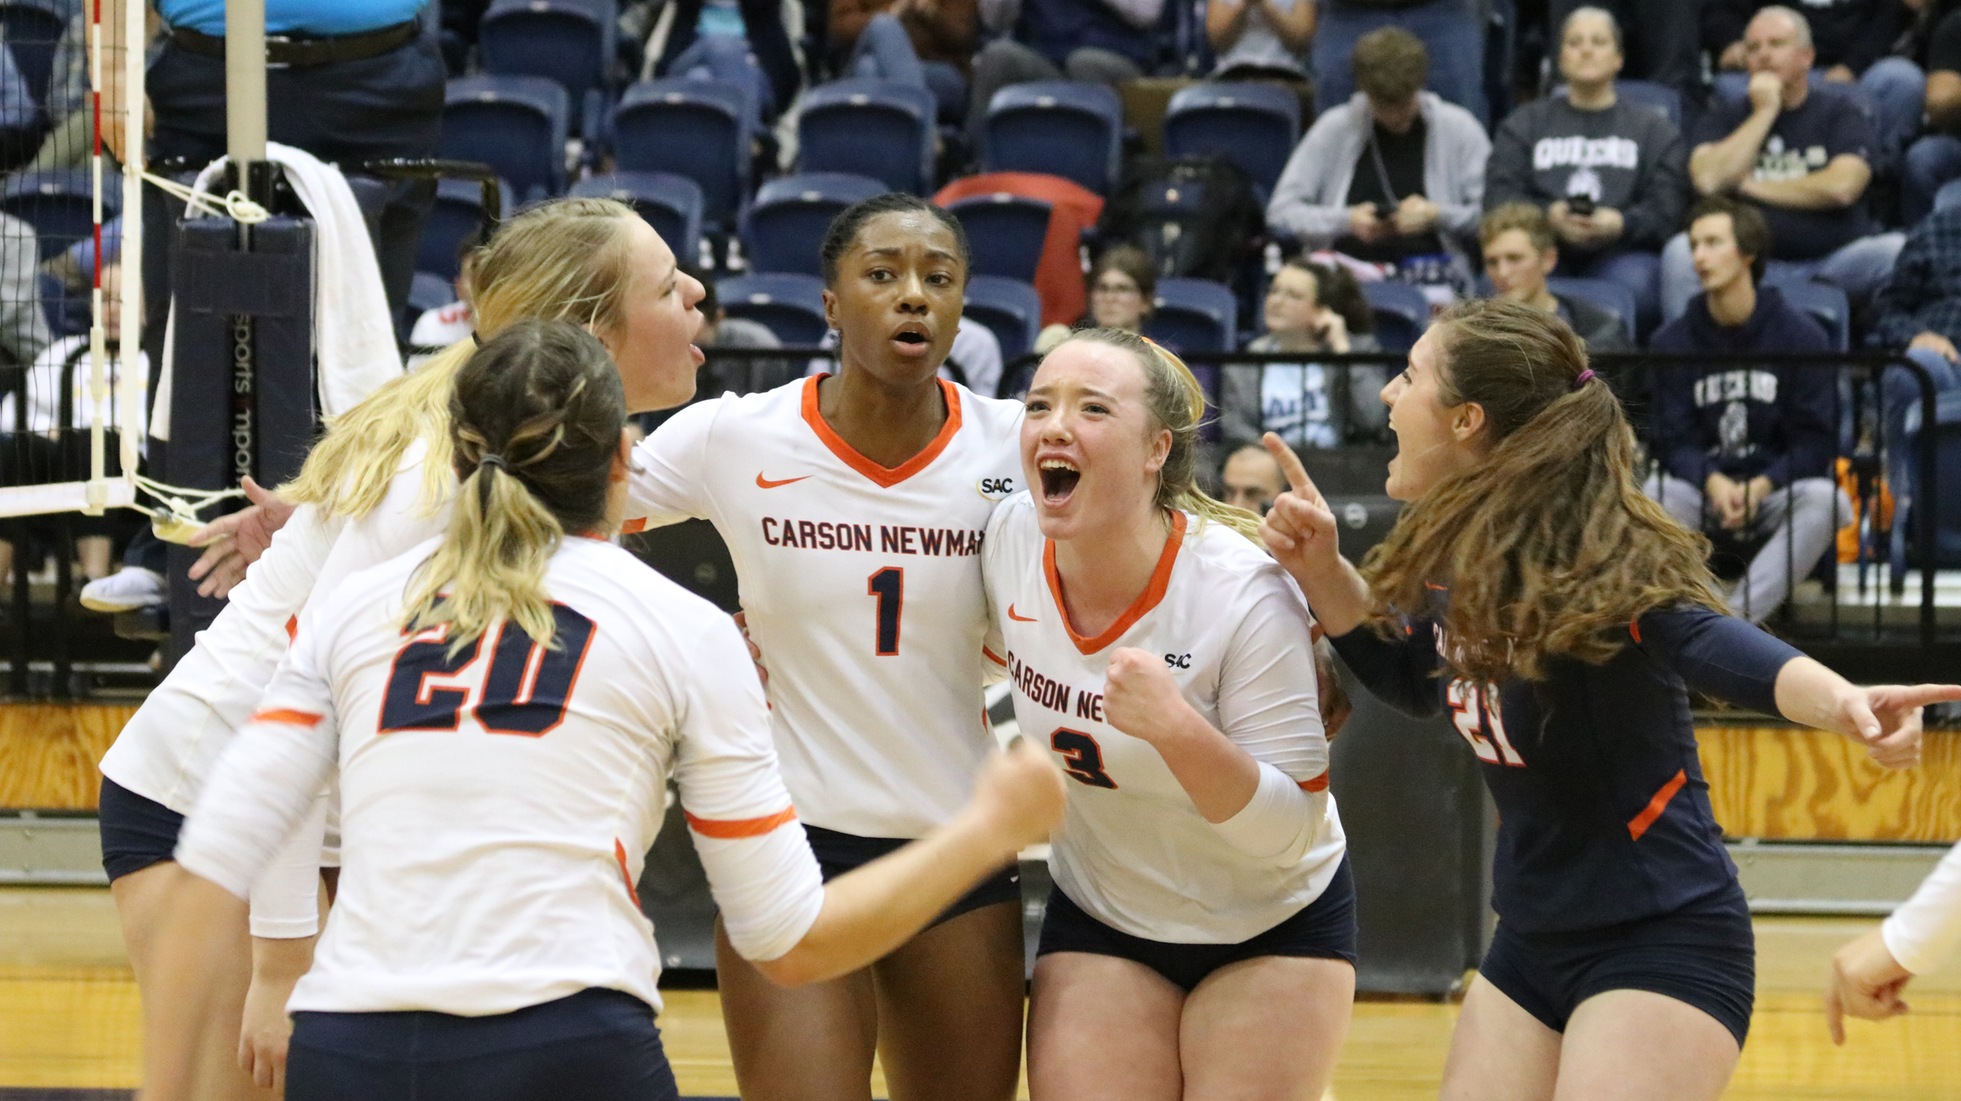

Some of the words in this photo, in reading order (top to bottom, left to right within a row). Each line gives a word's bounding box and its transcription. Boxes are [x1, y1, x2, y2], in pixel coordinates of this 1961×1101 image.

[981, 477, 1013, 494] SAC
[761, 516, 873, 552] CARSON
[867, 565, 904, 657] 1
[376, 592, 598, 739] 20
[1007, 650, 1071, 714] CARSON
[1446, 676, 1528, 767] 21
[1050, 726, 1119, 790] 3
